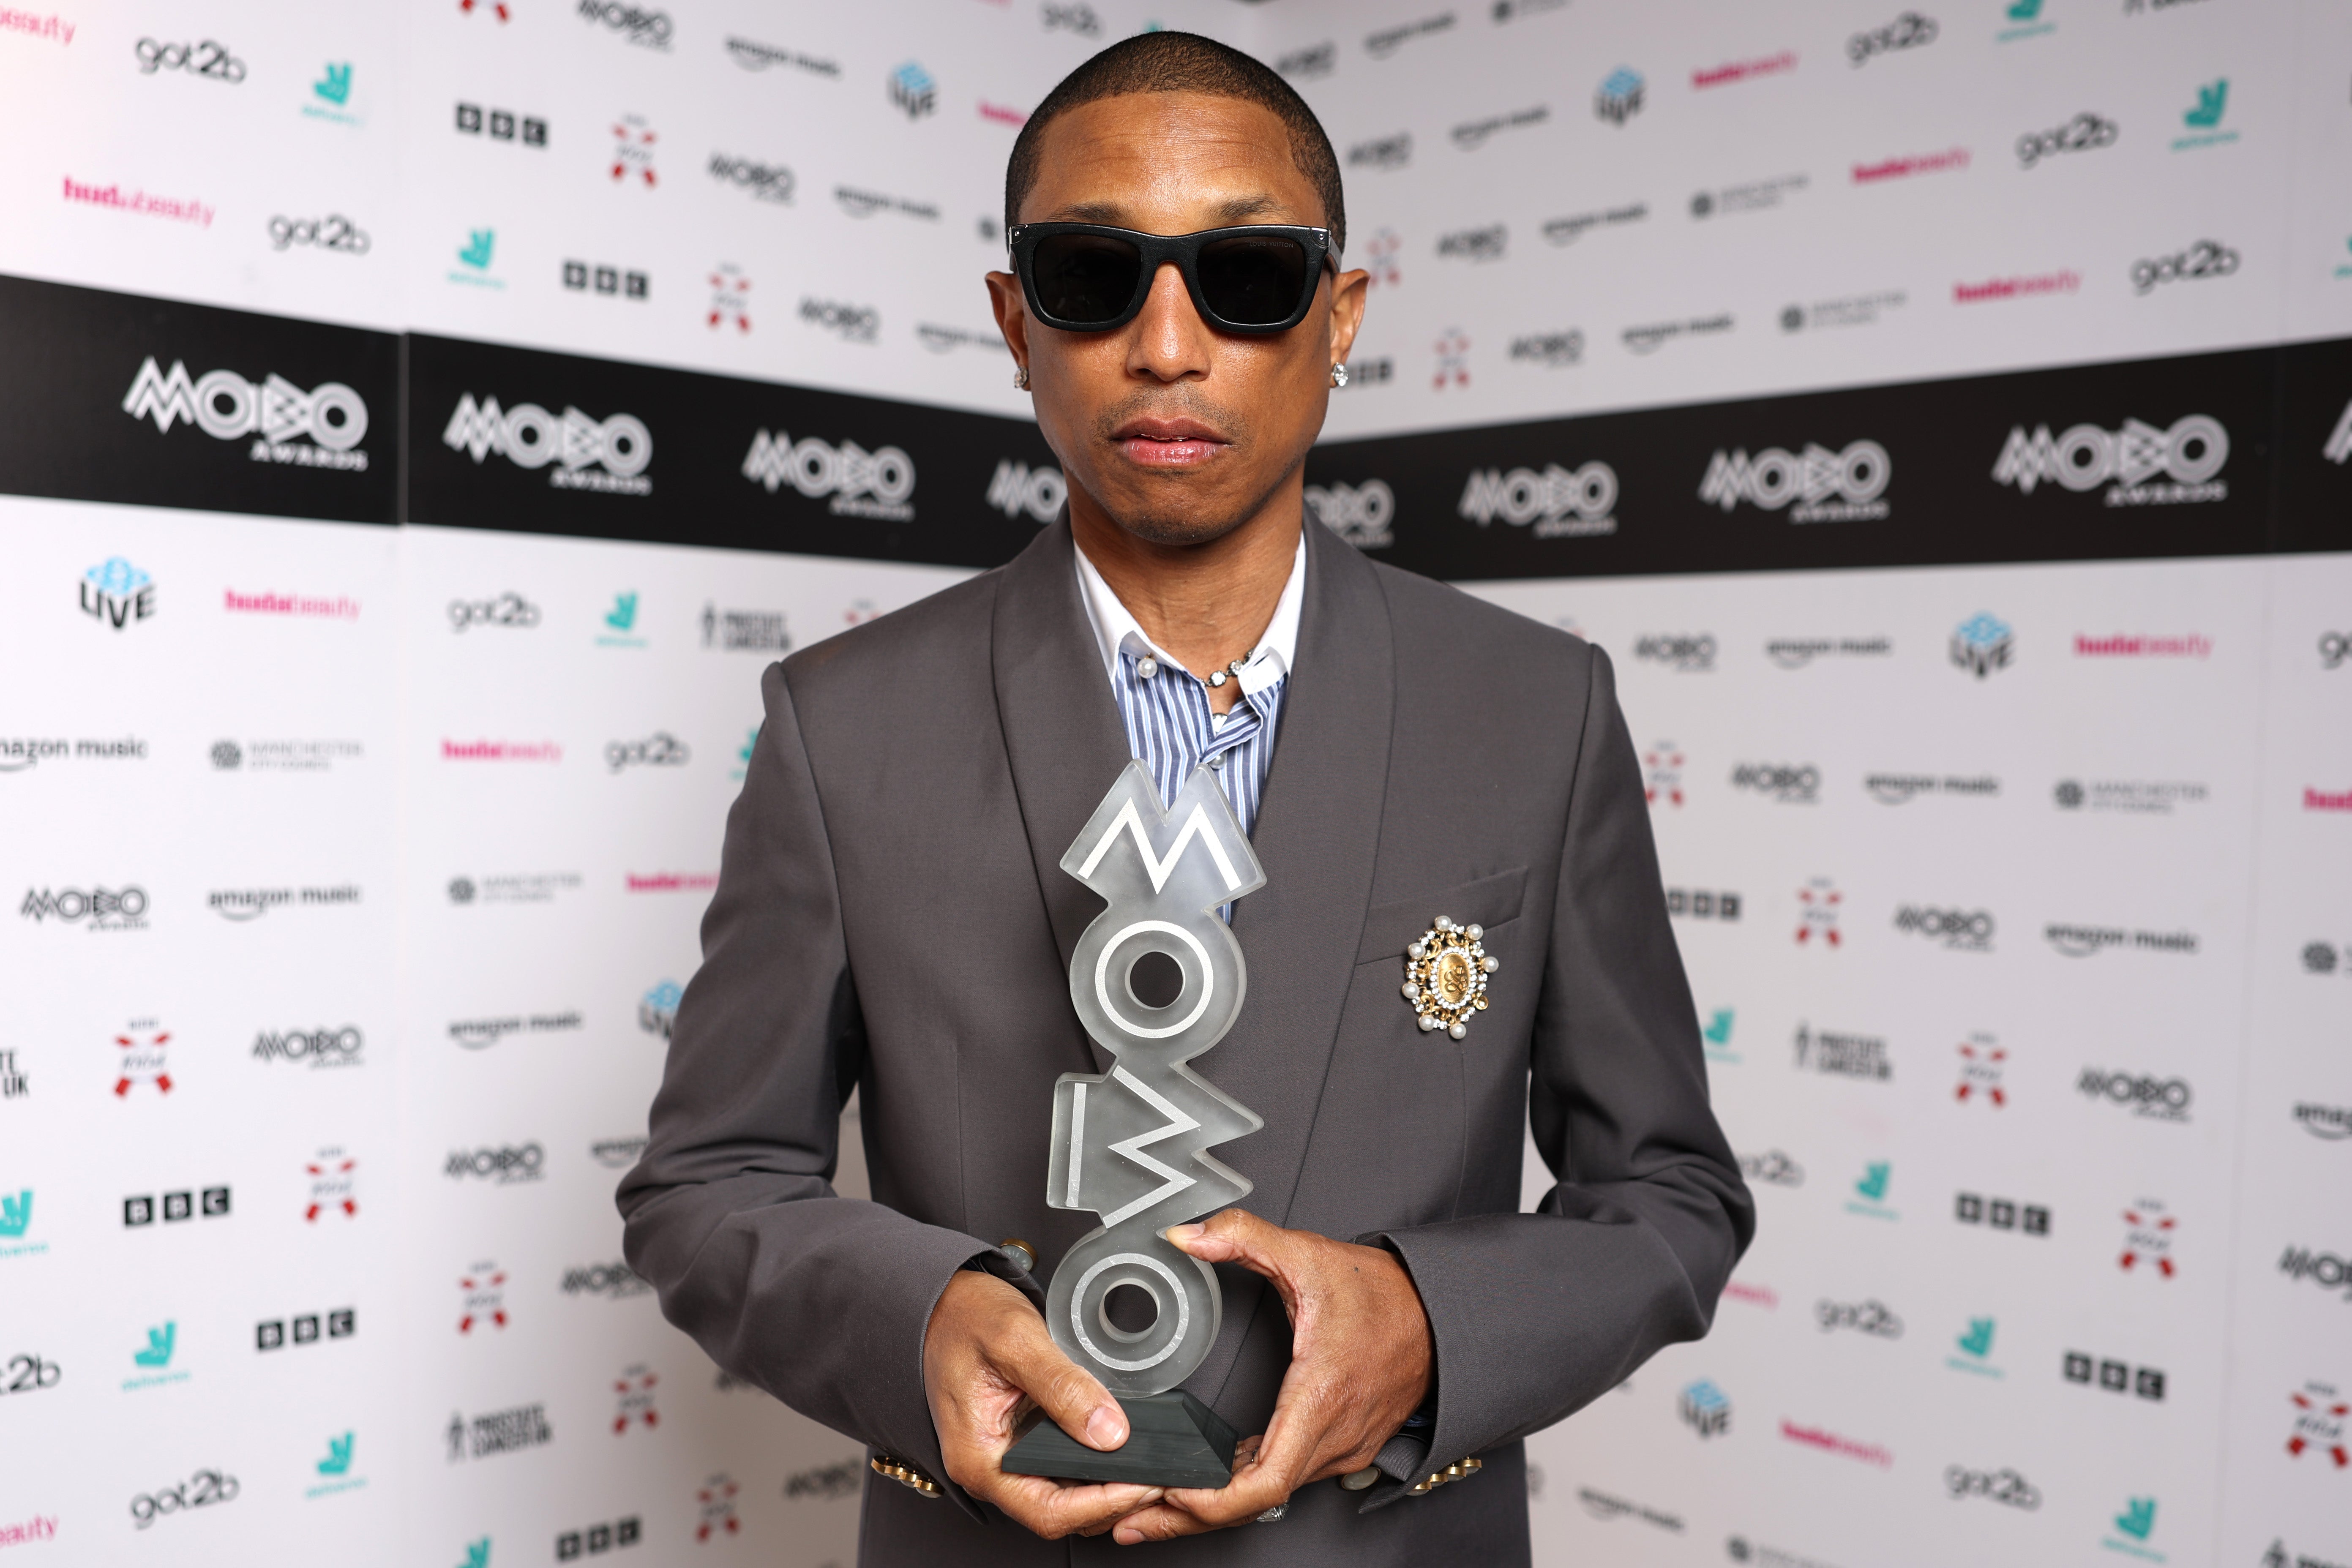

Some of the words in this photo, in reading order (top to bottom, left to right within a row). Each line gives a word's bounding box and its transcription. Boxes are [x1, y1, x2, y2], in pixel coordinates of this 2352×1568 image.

[135, 38, 246, 83] got2b
[2017, 112, 2118, 169] got2b
[269, 214, 370, 254] got2b
[2132, 240, 2240, 295] got2b
[123, 357, 368, 452] MOBO
[248, 438, 369, 473] AWARDS
[444, 394, 652, 475] MOBO
[1993, 415, 2229, 494] MOBO
[743, 431, 915, 503] MOBO
[984, 457, 1067, 524] MO
[1460, 461, 1618, 526] MOBO
[1700, 440, 1891, 512] MOBO
[1304, 477, 1395, 533] OBO
[79, 577, 156, 632] LIVE
[449, 592, 541, 632] got2b
[76, 734, 148, 759] music
[20, 886, 149, 921] MOBO
[123, 1186, 231, 1227] BBC
[256, 1308, 355, 1352] BBC
[130, 1470, 239, 1530] got2b
